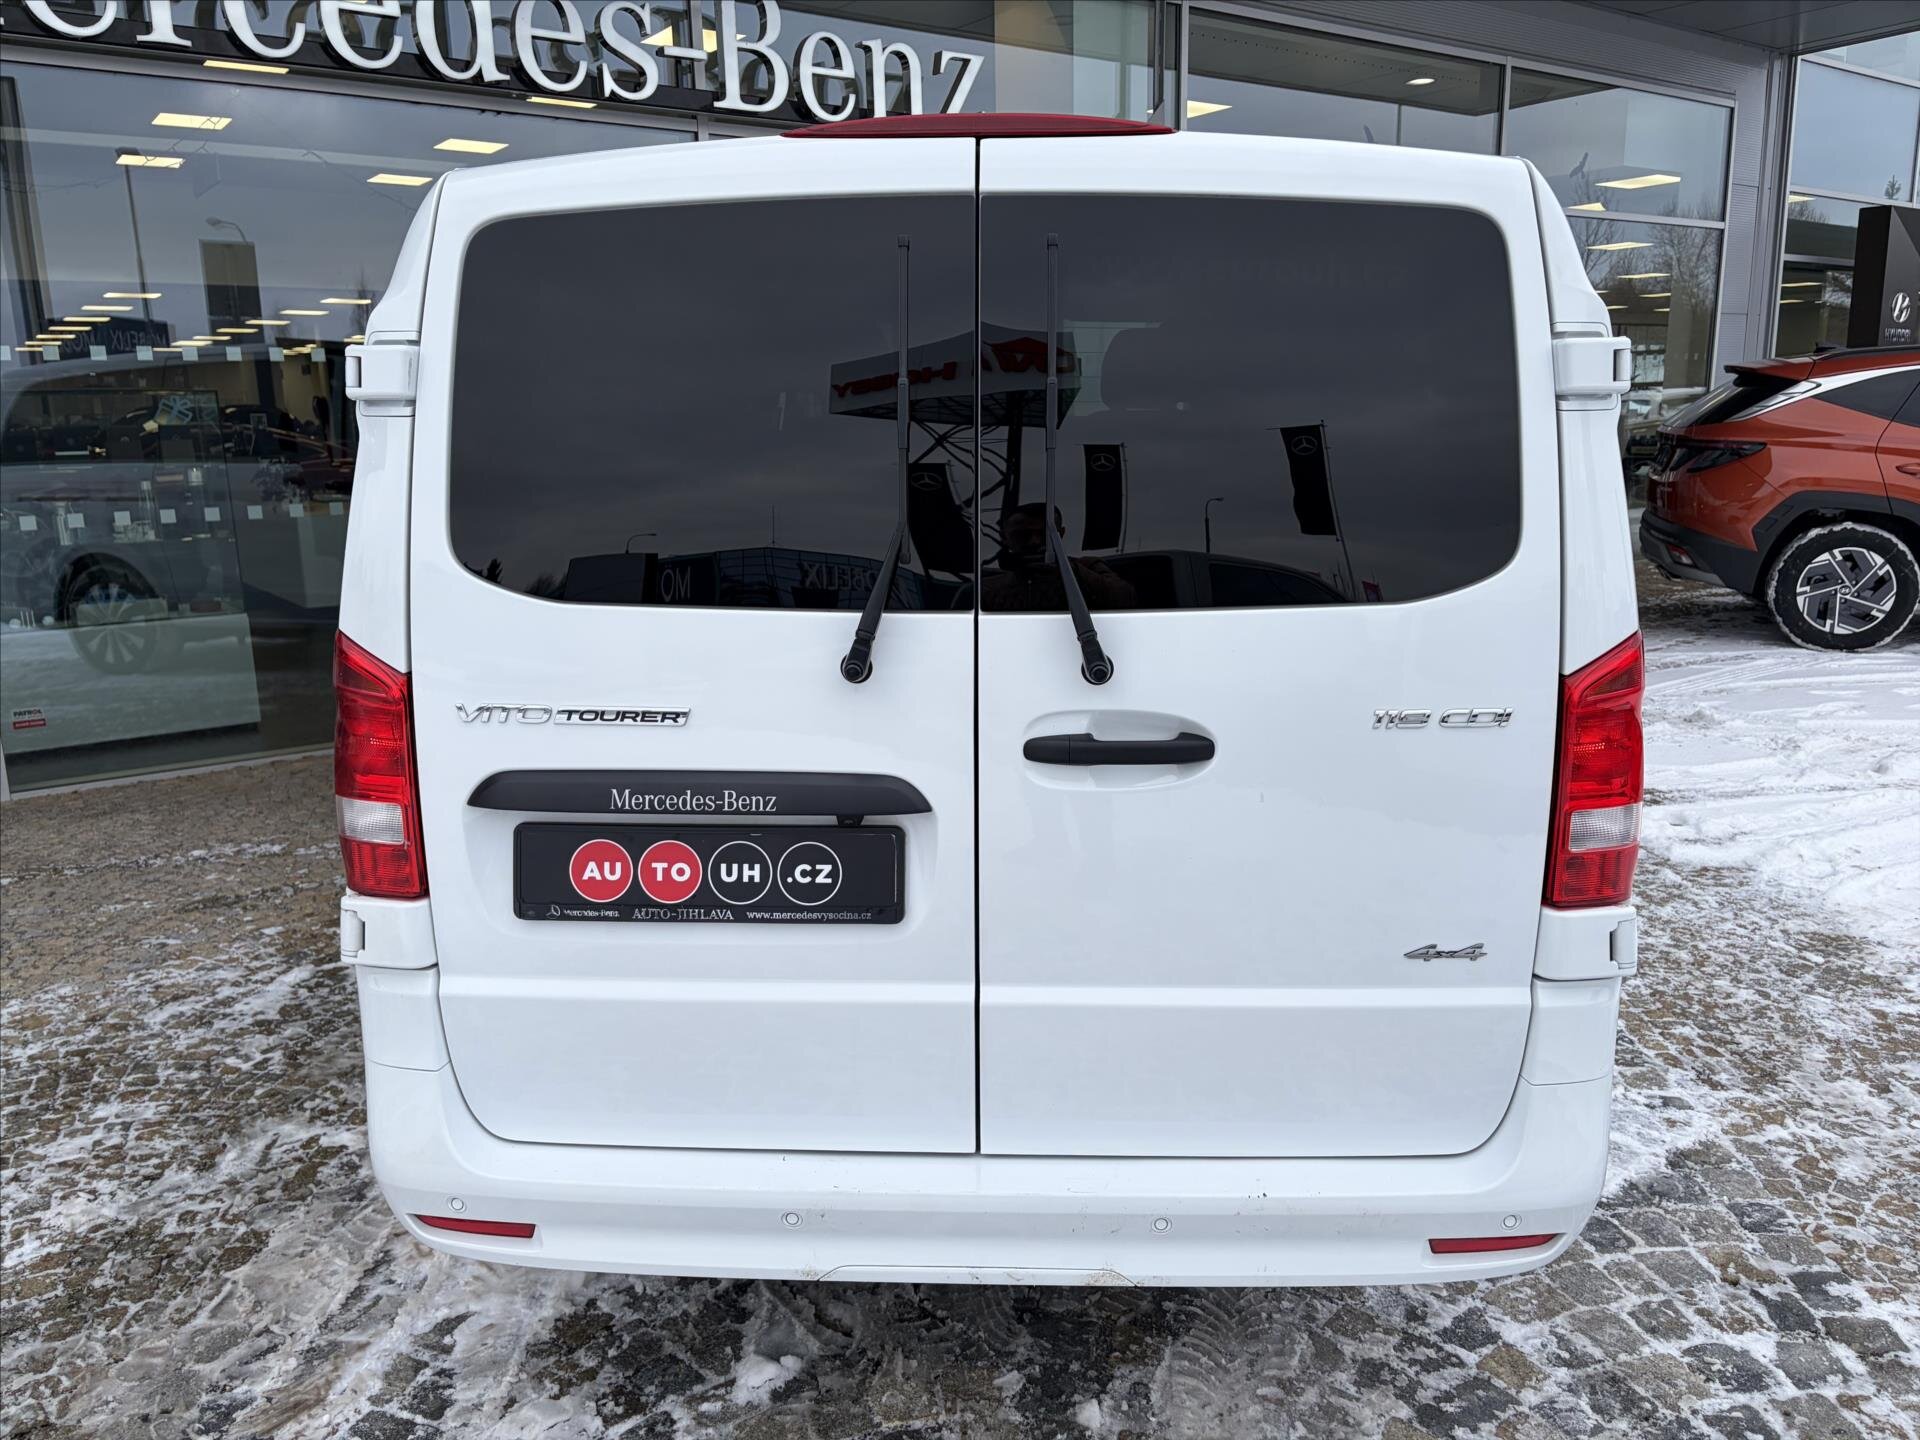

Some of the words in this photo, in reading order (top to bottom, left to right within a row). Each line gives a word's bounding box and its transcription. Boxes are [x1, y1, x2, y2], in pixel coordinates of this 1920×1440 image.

[0, 0, 985, 122] cedes-Benz
[455, 703, 552, 724] VITO
[558, 709, 682, 724] TOURER
[1439, 707, 1514, 729] CDI
[609, 788, 778, 812] Mercedes-Benz
[582, 861, 622, 881] AU
[651, 862, 691, 882] TO
[720, 863, 761, 883] UH
[786, 864, 833, 884] .CZ
[632, 908, 734, 920] AUTO-JIHLAVA
[746, 911, 872, 921] www.mercedesvysocina.cz
[1403, 943, 1488, 961] 4x4
